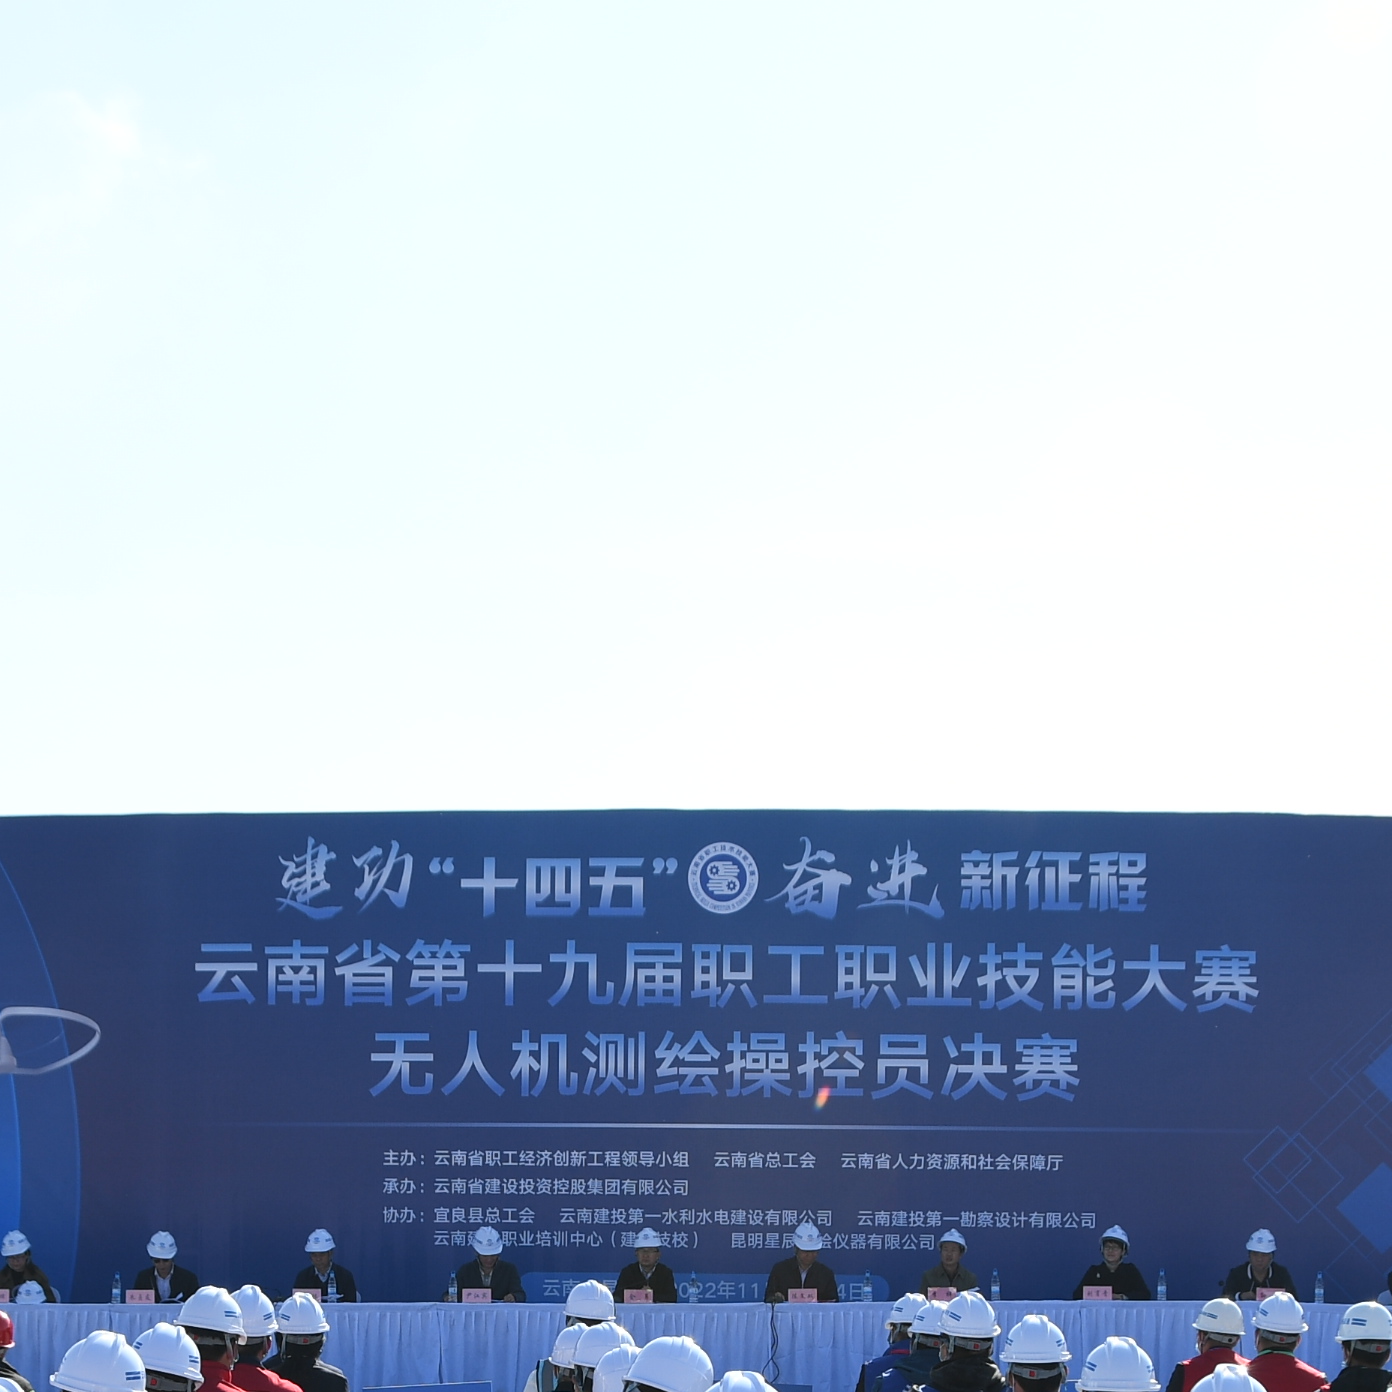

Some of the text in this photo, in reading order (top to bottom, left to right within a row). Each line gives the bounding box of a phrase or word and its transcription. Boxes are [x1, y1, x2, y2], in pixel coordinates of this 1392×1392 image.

[194, 938, 1260, 1014] 云南省第十九届职工职业技能大赛
[368, 1029, 1081, 1102] 无人机测绘操控员决赛
[713, 1152, 817, 1169] 云南省总工会
[840, 1153, 1064, 1172] 云南省人力资源和社会保障厅
[559, 1207, 833, 1227] 云南建投第一水利水电建设有限公司
[857, 1210, 1096, 1229] 云南建投第一勘察设计有限公司
[731, 1231, 935, 1251] 昆明星辰绘仪器有限公司
